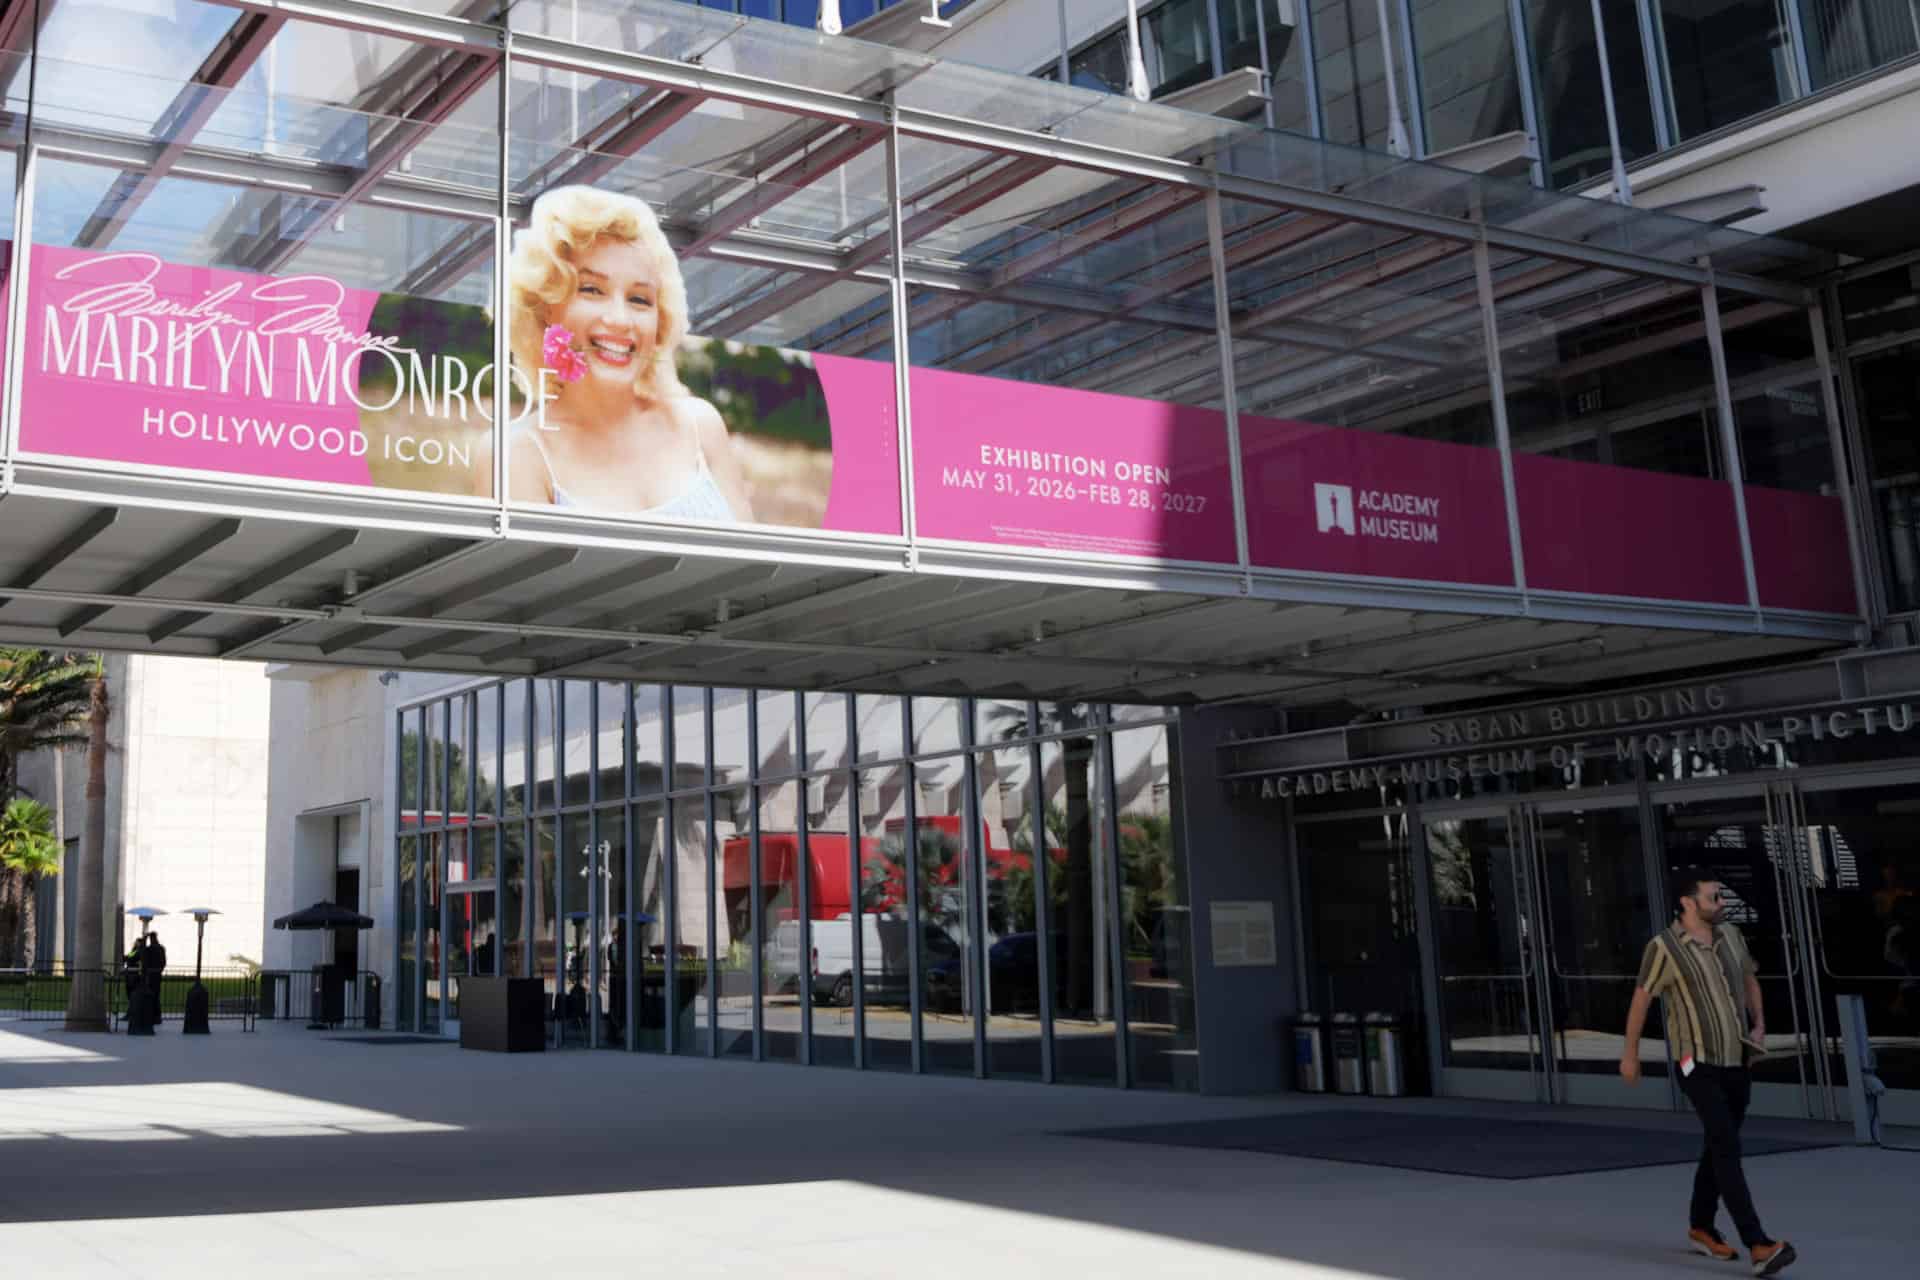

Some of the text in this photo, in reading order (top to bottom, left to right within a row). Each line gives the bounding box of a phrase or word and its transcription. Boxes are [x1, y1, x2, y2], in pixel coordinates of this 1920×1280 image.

[41, 303, 561, 432] MARILYN MONROE
[142, 407, 471, 468] HOLLYWOOD ICON
[942, 466, 987, 490] MAY
[993, 473, 1021, 498] 31,
[1127, 488, 1157, 512] 28,
[1163, 492, 1208, 514] 2027
[980, 444, 1171, 486] EXHIBITION OPEN
[1358, 489, 1440, 518] ACADEMY
[1359, 515, 1439, 545] MUSEUM
[1429, 684, 1727, 746] SABAN BUILDING
[1260, 703, 1913, 800] ACADEMY MUSEUM OF MOTION PICTU
